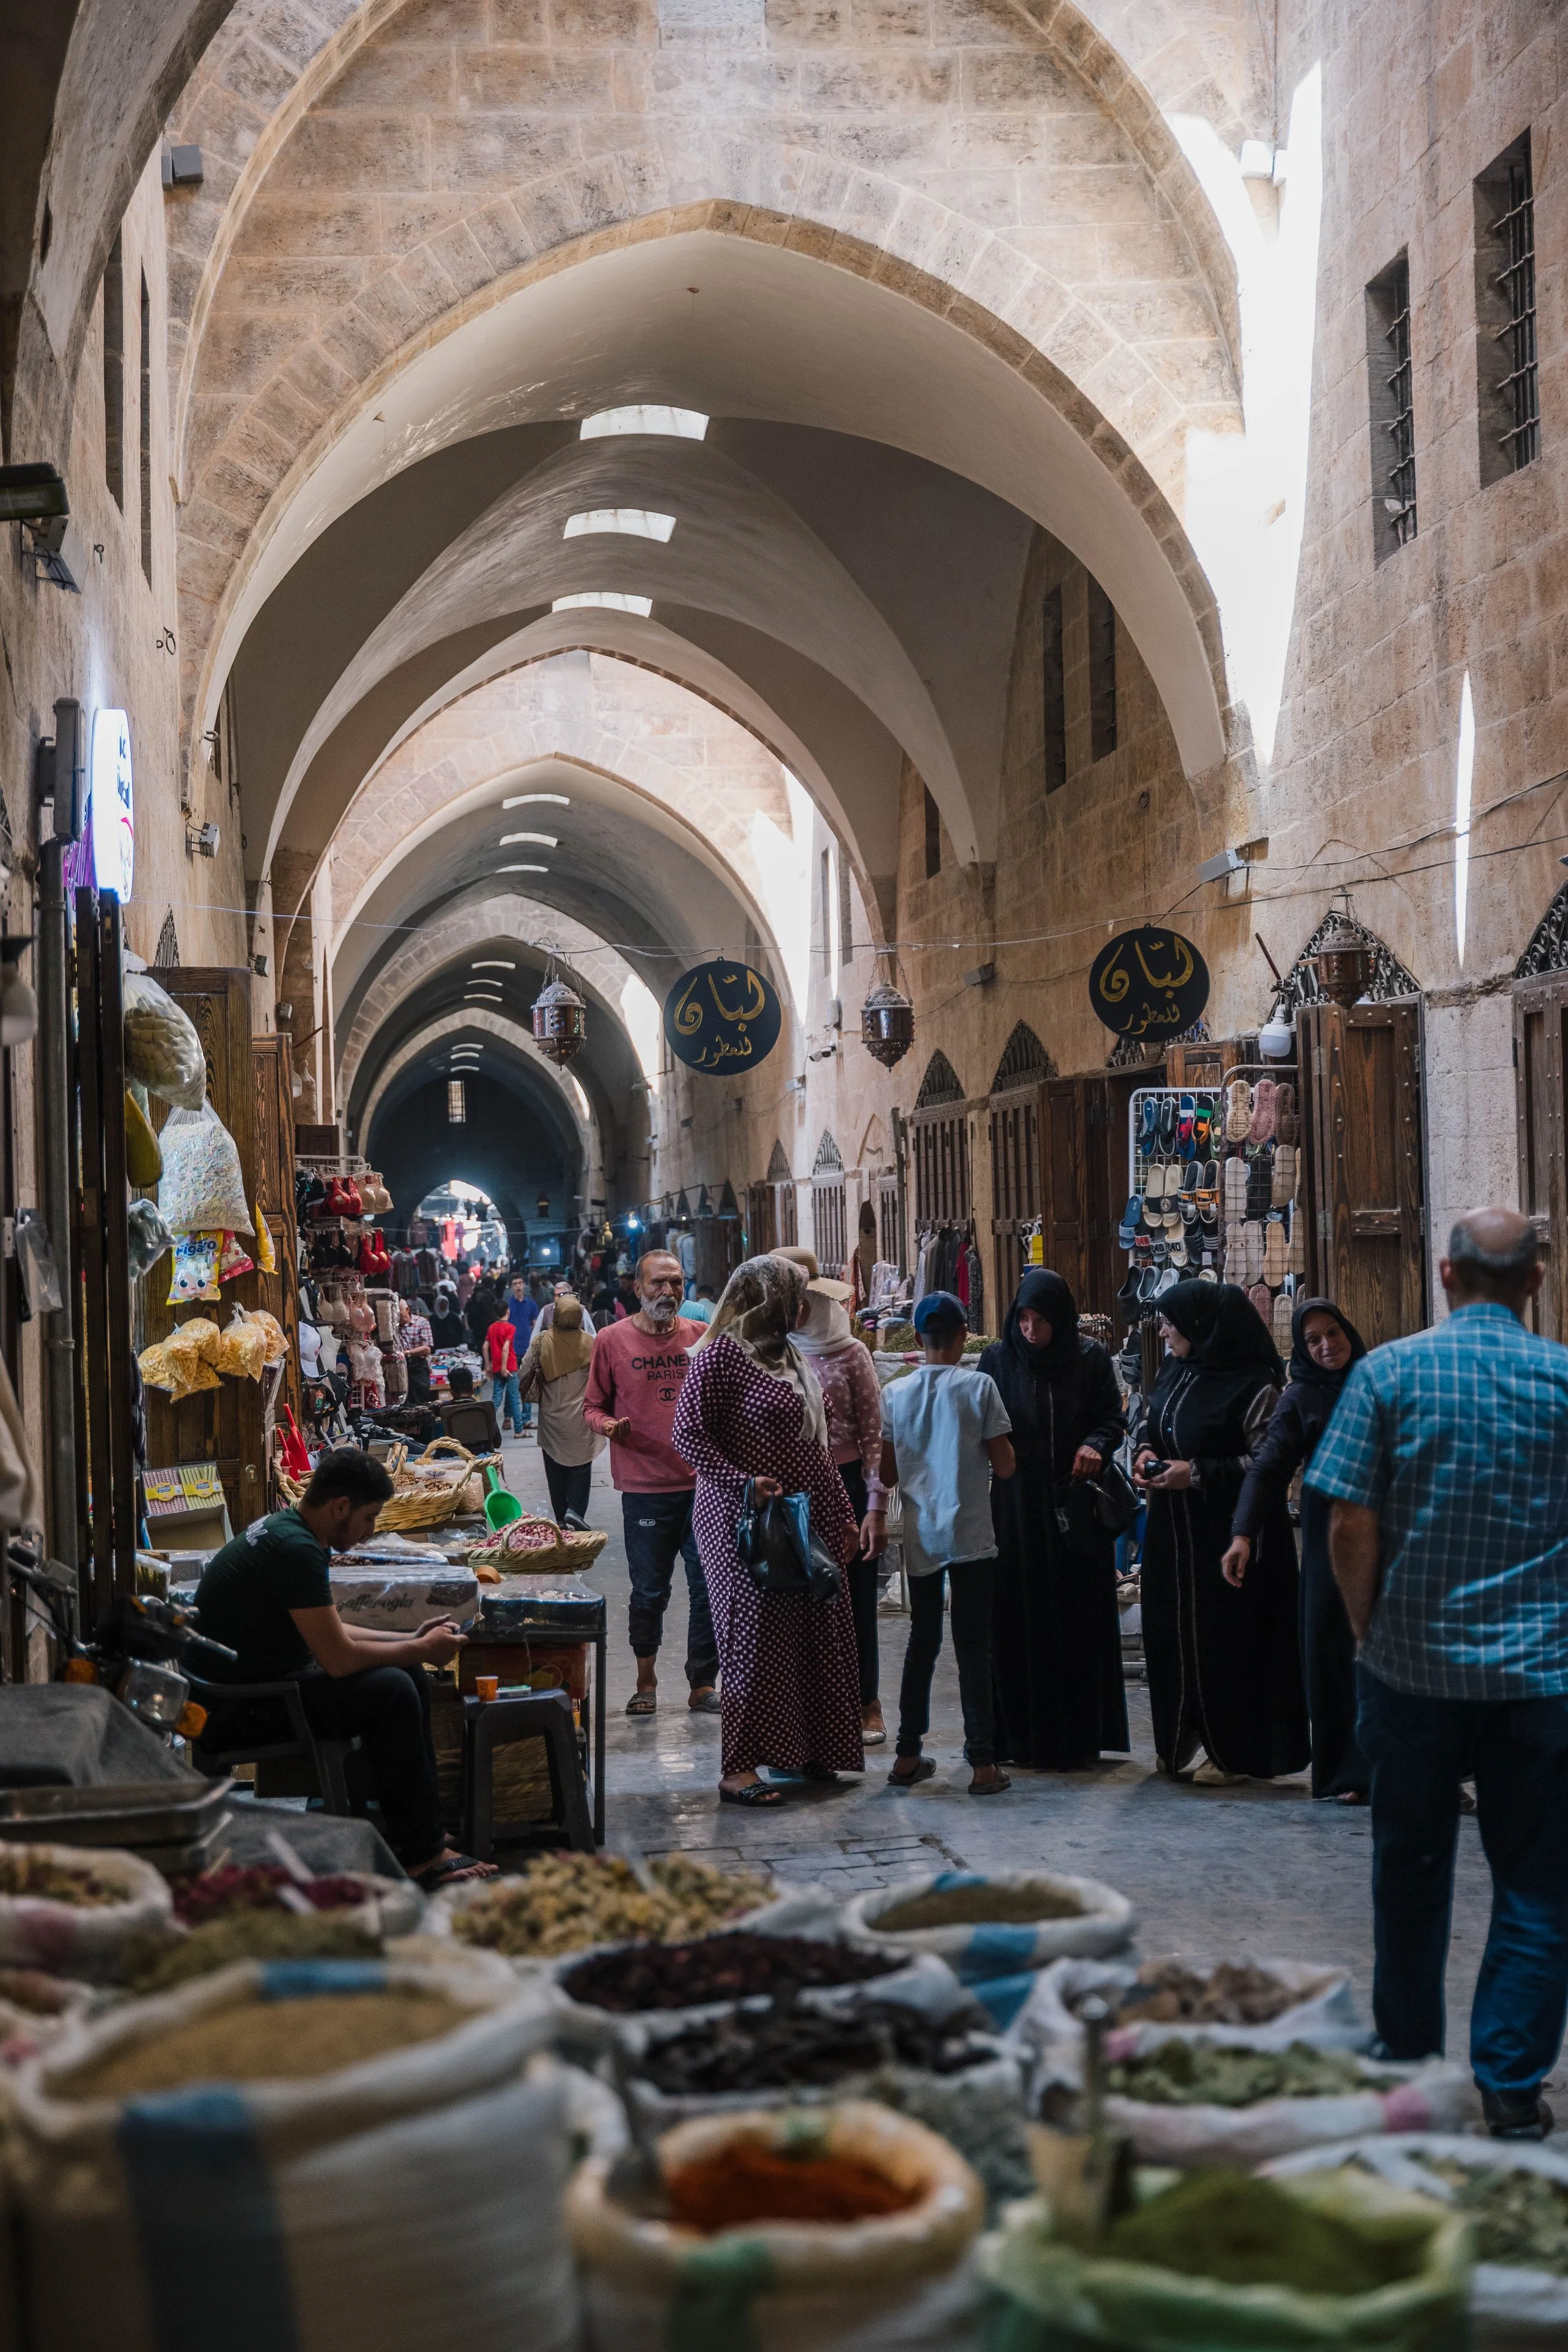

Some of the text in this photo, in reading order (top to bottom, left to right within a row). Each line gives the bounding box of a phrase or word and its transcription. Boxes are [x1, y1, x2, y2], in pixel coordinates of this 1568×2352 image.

[1119, 1002, 1180, 1034] للعطور
[692, 1035, 752, 1067] للعطور
[647, 1369, 684, 1380] PARIS
